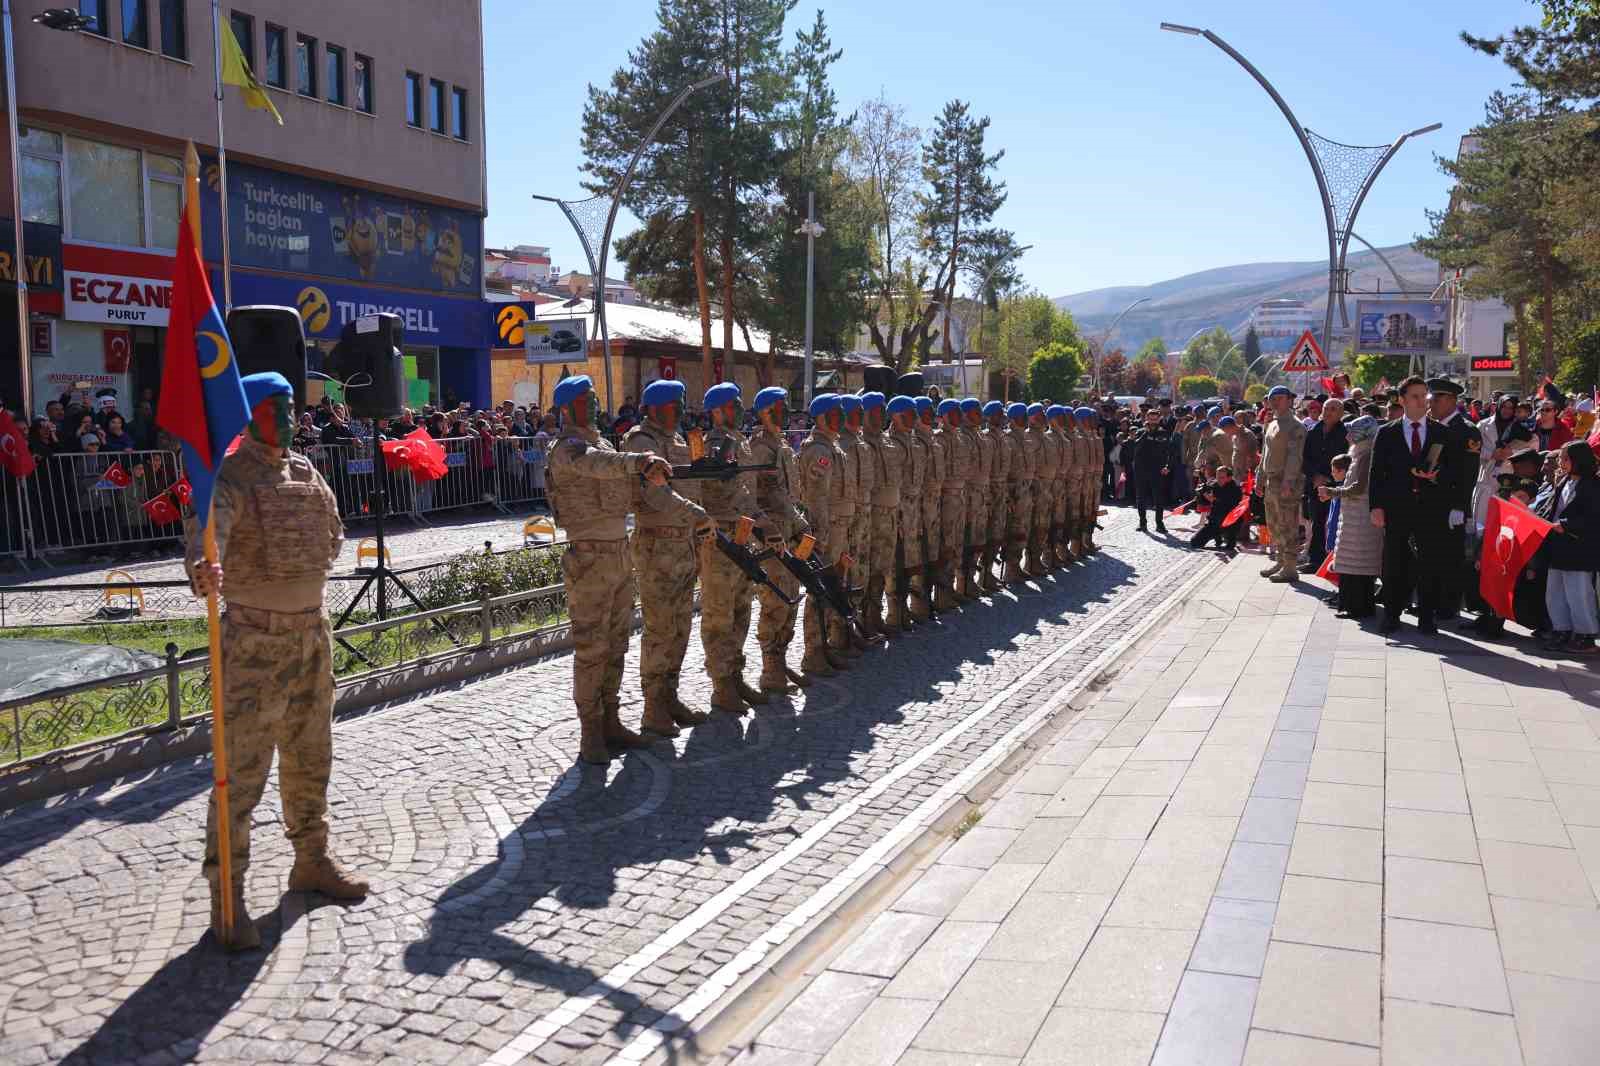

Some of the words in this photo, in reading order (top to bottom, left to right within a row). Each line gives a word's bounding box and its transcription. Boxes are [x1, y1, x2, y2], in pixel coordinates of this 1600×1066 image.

[243, 182, 324, 214] Turkcell'le
[244, 204, 303, 231] bağlan
[107, 308, 147, 321] PURUT
